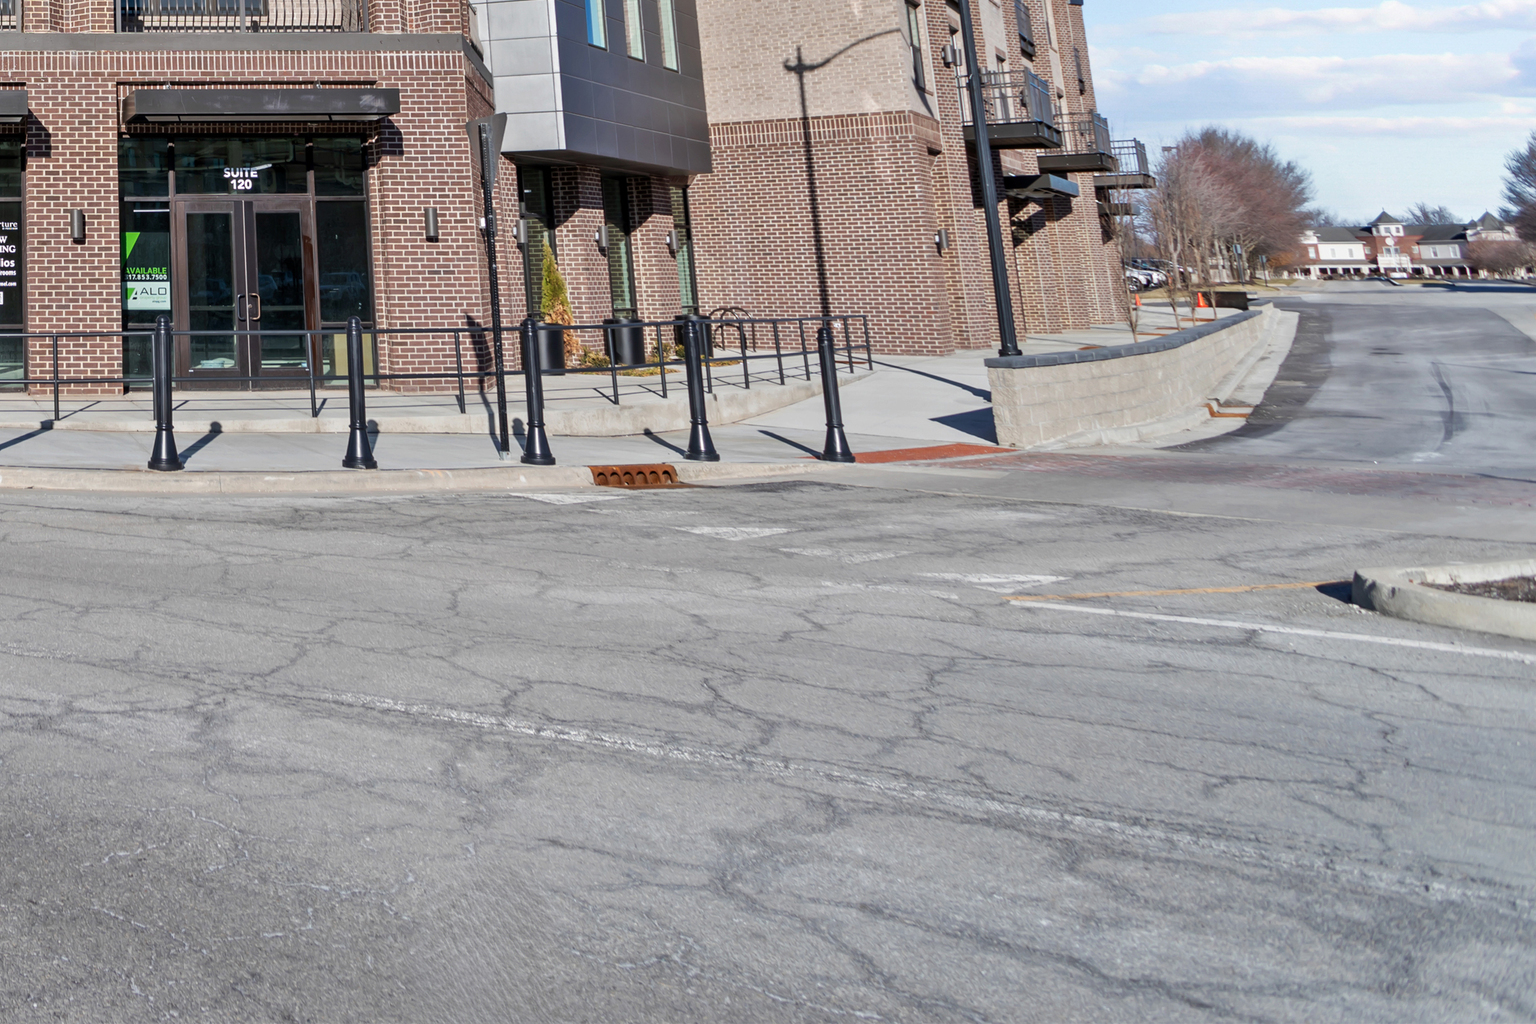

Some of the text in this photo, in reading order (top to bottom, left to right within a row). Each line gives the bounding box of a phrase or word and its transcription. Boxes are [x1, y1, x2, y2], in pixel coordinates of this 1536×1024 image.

[224, 167, 258, 178] SUITE
[230, 179, 253, 190] 120
[126, 267, 167, 275] AVAILABLE
[140, 287, 167, 296] ALO
